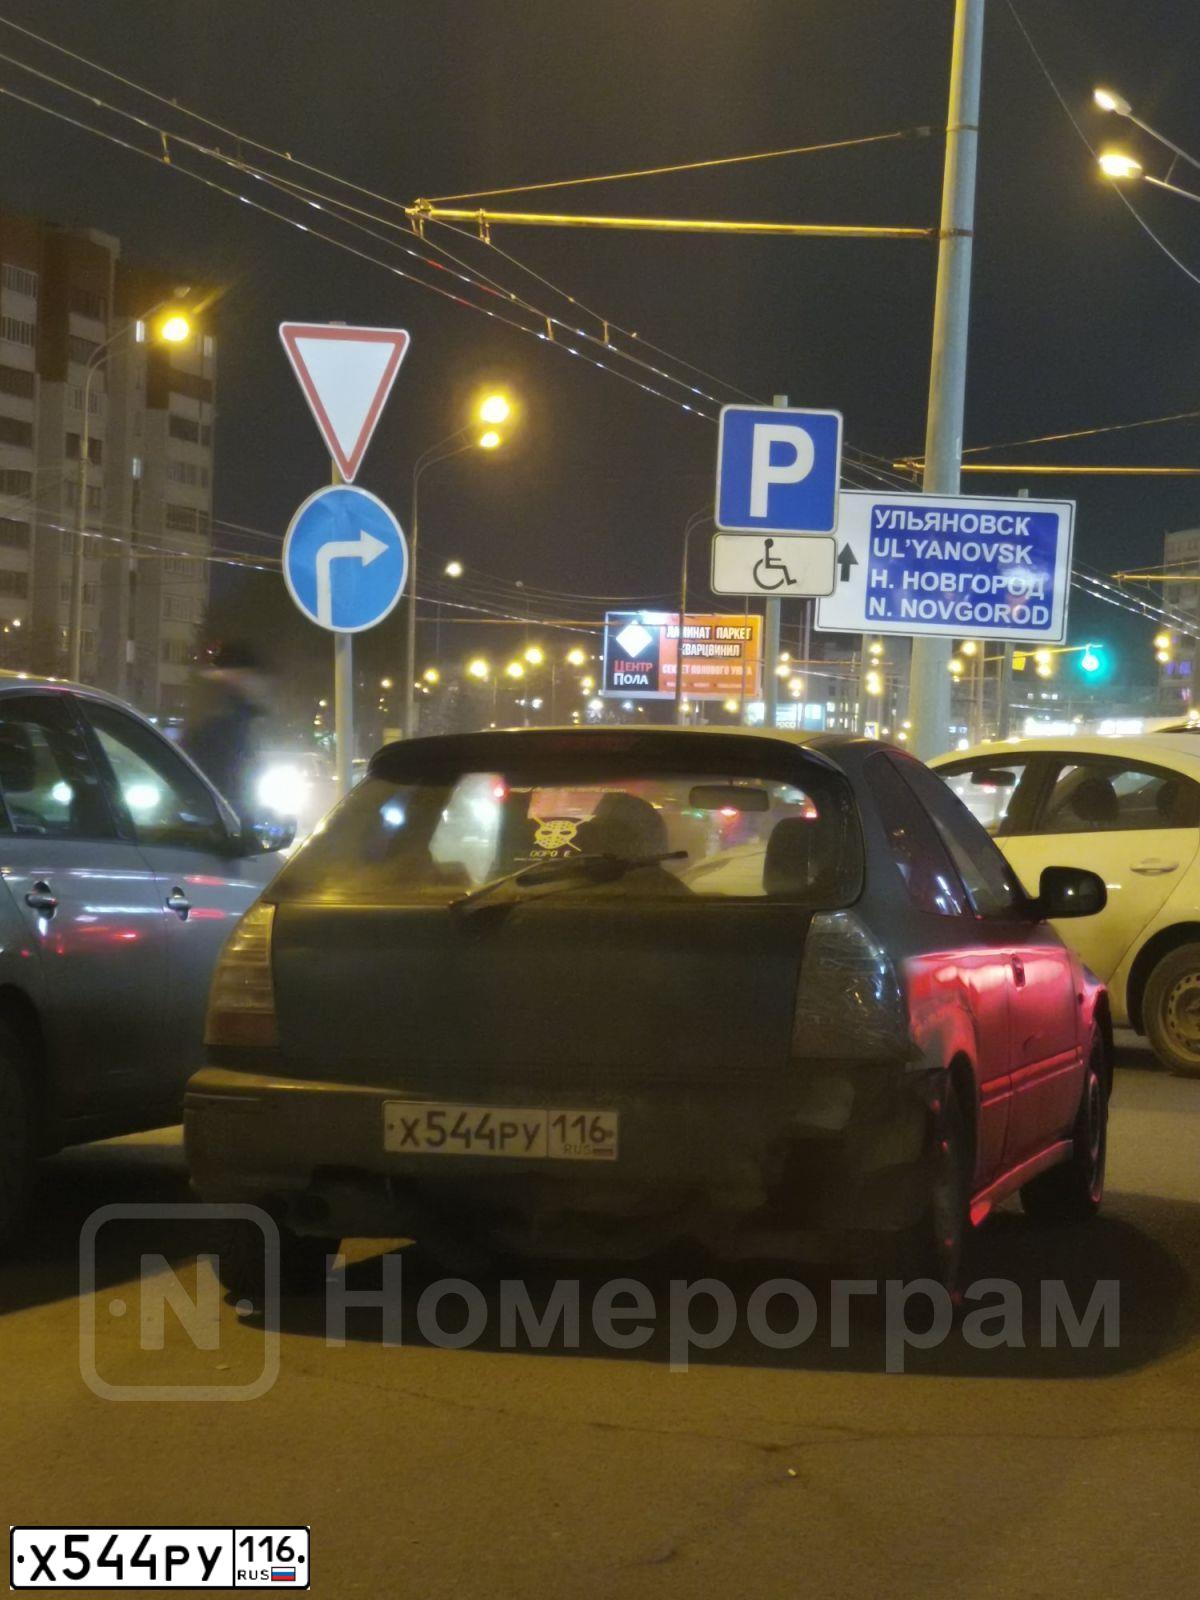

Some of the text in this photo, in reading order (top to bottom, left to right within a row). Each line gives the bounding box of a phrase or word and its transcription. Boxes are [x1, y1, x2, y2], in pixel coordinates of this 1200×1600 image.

[750, 423, 814, 517] P
[874, 509, 1031, 536] УЛЬЯНОВСК
[871, 568, 1045, 600] Н. НОВГОРОД
[869, 597, 1050, 625] N. NOVGOROD
[715, 626, 752, 640] ПАРКЕТ
[400, 1110, 606, 1151] Х544РУ 116
[563, 1144, 592, 1156] RUS
